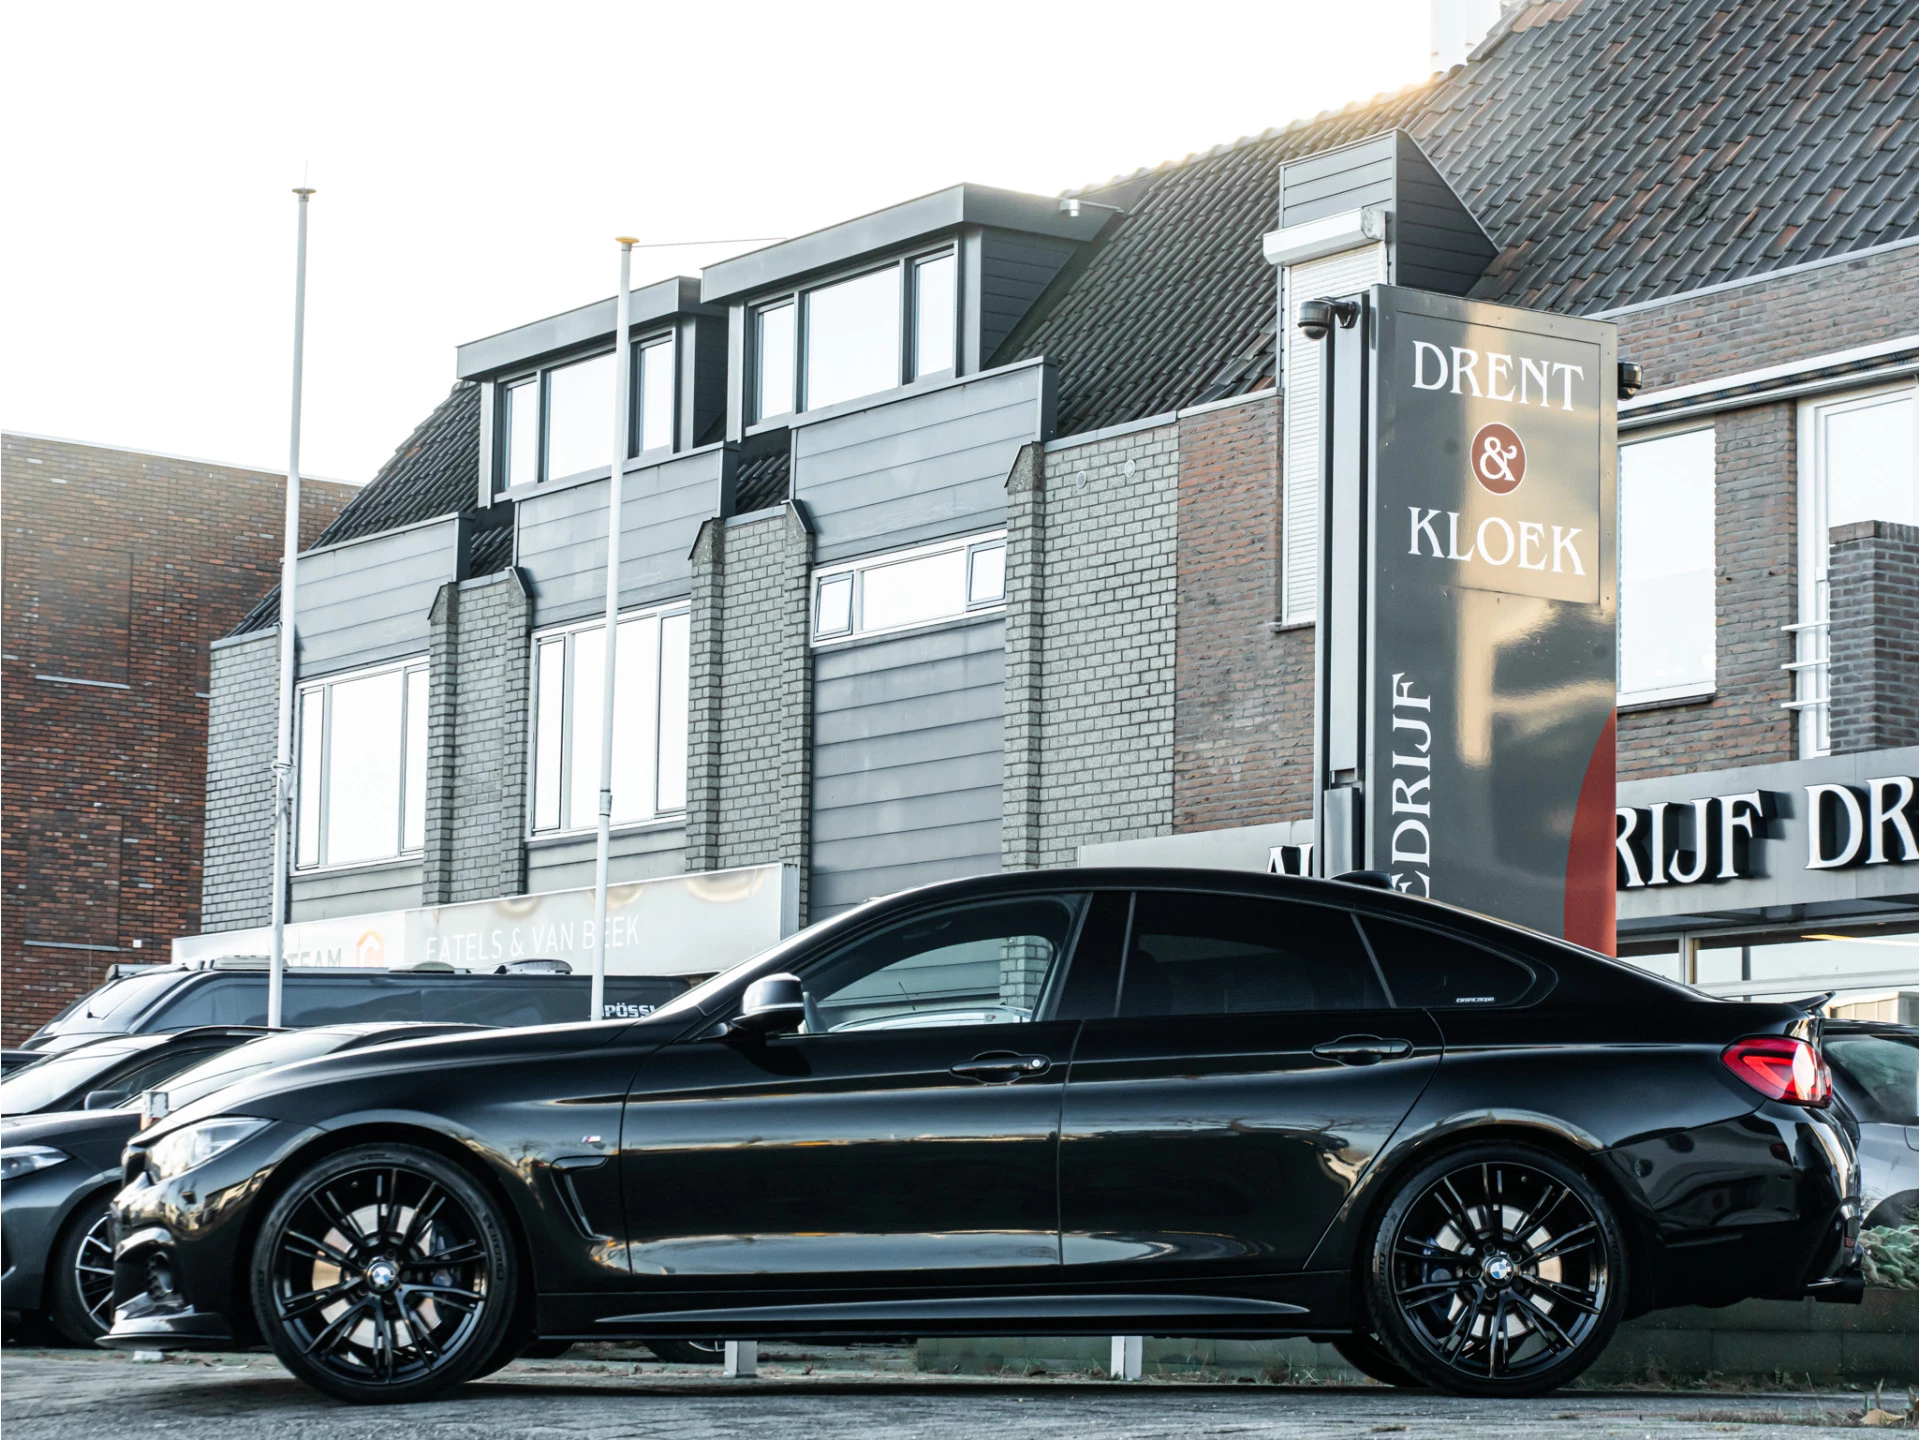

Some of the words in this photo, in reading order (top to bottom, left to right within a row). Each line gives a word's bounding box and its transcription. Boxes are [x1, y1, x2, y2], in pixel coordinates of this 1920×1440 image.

[1411, 340, 1584, 411] DRENT
[1479, 436, 1517, 482] &
[1407, 506, 1587, 575] KLOEK
[1805, 776, 1919, 869] DR
[510, 927, 524, 957] &
[532, 920, 575, 954] VAN
